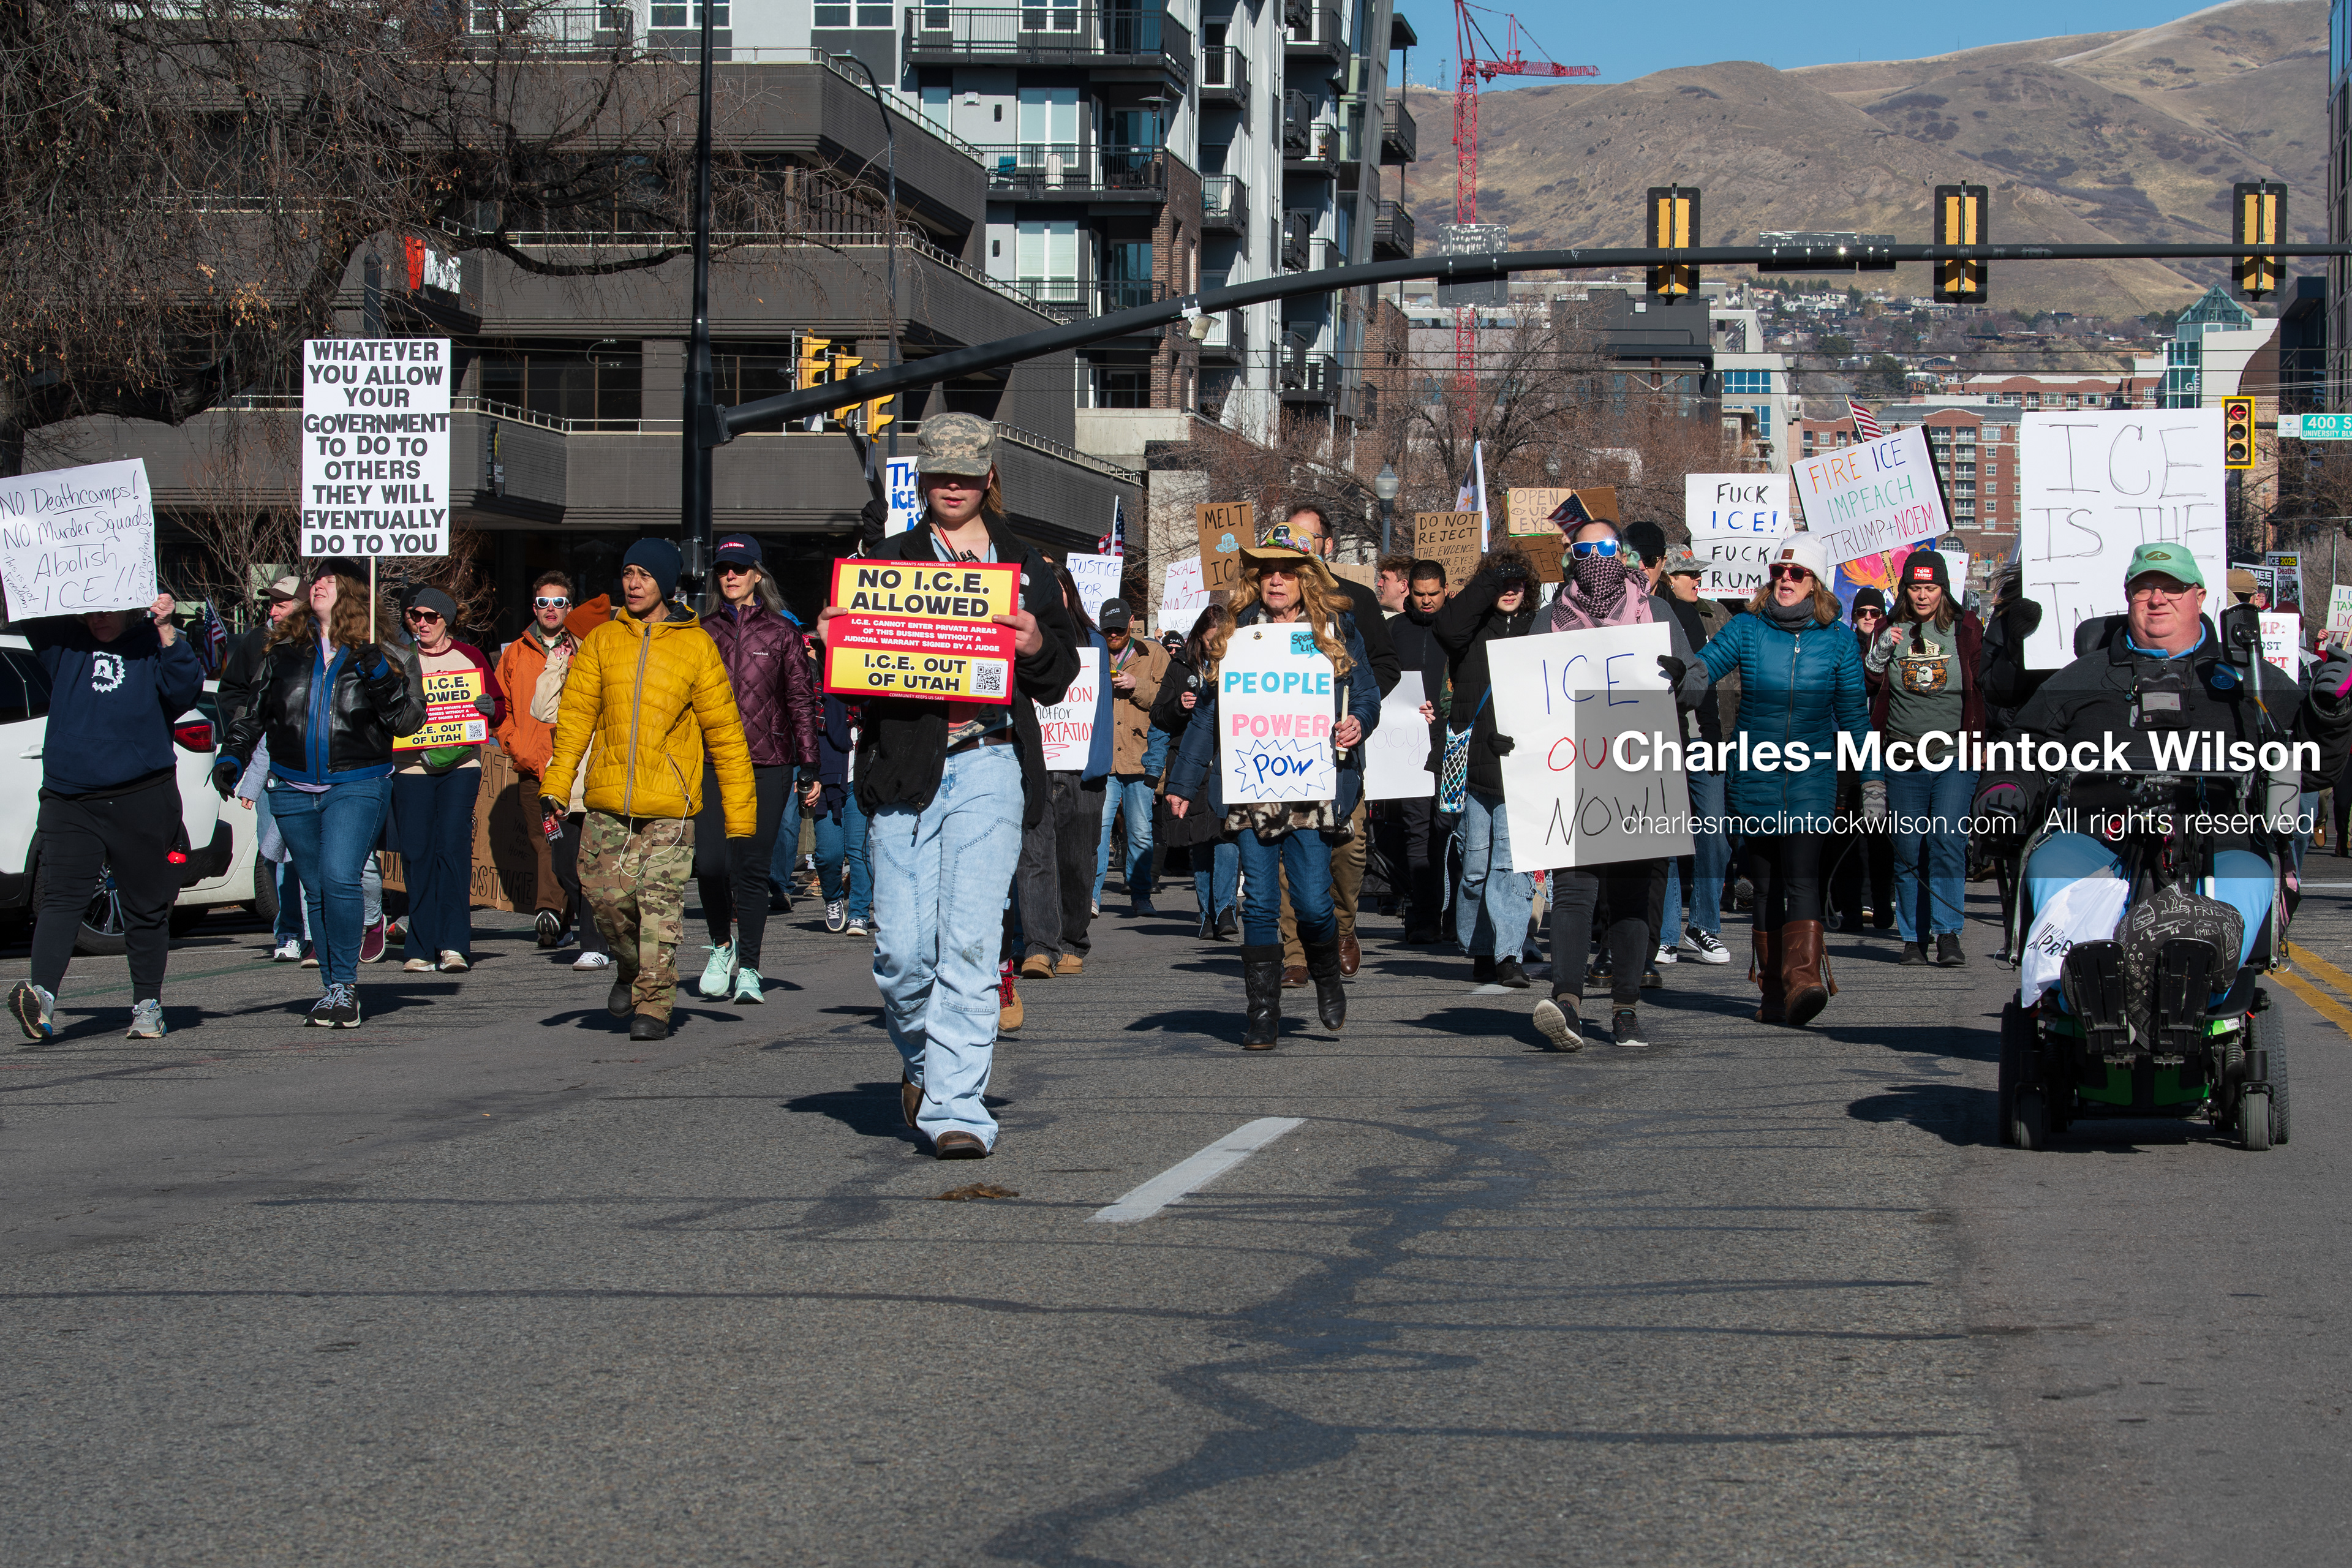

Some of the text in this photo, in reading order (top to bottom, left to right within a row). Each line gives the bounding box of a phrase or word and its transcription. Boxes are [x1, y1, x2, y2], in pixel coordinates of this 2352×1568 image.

[313, 341, 439, 361] WHATEVER
[308, 365, 443, 385] YOU ALLOW
[344, 388, 410, 407] YOUR
[304, 413, 450, 434] GOVERNMENT
[2307, 417, 2352, 429] 400 S
[317, 436, 428, 456] TO DO TO
[325, 460, 420, 480] OTHERS
[1808, 439, 1906, 494] FIRE ICE
[2038, 424, 2207, 499] ICE
[313, 484, 434, 504] THEY WILL
[1514, 489, 1558, 505] OPEN
[1717, 483, 1769, 504] FUCK
[1827, 475, 1914, 524] IMPEACH
[0, 491, 24, 519] NO
[303, 508, 446, 529] EVENTUALLY
[1205, 504, 1246, 530] MELT
[1420, 513, 1479, 530] DO NOT
[1520, 518, 1555, 532] EYES
[4, 522, 30, 549] NO
[38, 518, 95, 545] Murder
[311, 533, 437, 553] DO TO YOU
[1419, 527, 1478, 545] REJECT
[2029, 508, 2103, 562] IS
[1417, 544, 1474, 559] THE EVIDENCE
[1453, 556, 1473, 566] EYES
[1711, 546, 1770, 565] FUCK
[34, 543, 117, 584] Abolish
[1069, 559, 1121, 576] JUSTICE
[858, 569, 989, 595] NO I.C.E.
[1078, 581, 1102, 597] FOR
[1181, 580, 1188, 595] A
[850, 592, 989, 617] ALLOWED
[873, 620, 905, 628] CANNOT
[843, 635, 878, 644] JUDICIAL
[880, 638, 919, 646] WARRANT
[896, 630, 935, 638] BUSINESS
[937, 633, 973, 641] WITHOUT
[864, 654, 967, 674] I.C.E. OUT
[428, 676, 469, 690] I.C.E.
[868, 673, 960, 692] OF UTAH
[1224, 671, 1330, 695] PEOPLE
[1543, 654, 1639, 714] ICE
[440, 723, 462, 732] OUT
[1232, 714, 1330, 738] POWER
[431, 734, 461, 743] UTAH
[1253, 753, 1314, 784] POW
[1545, 778, 1667, 845] NOW!
[508, 845, 530, 861] HOME
